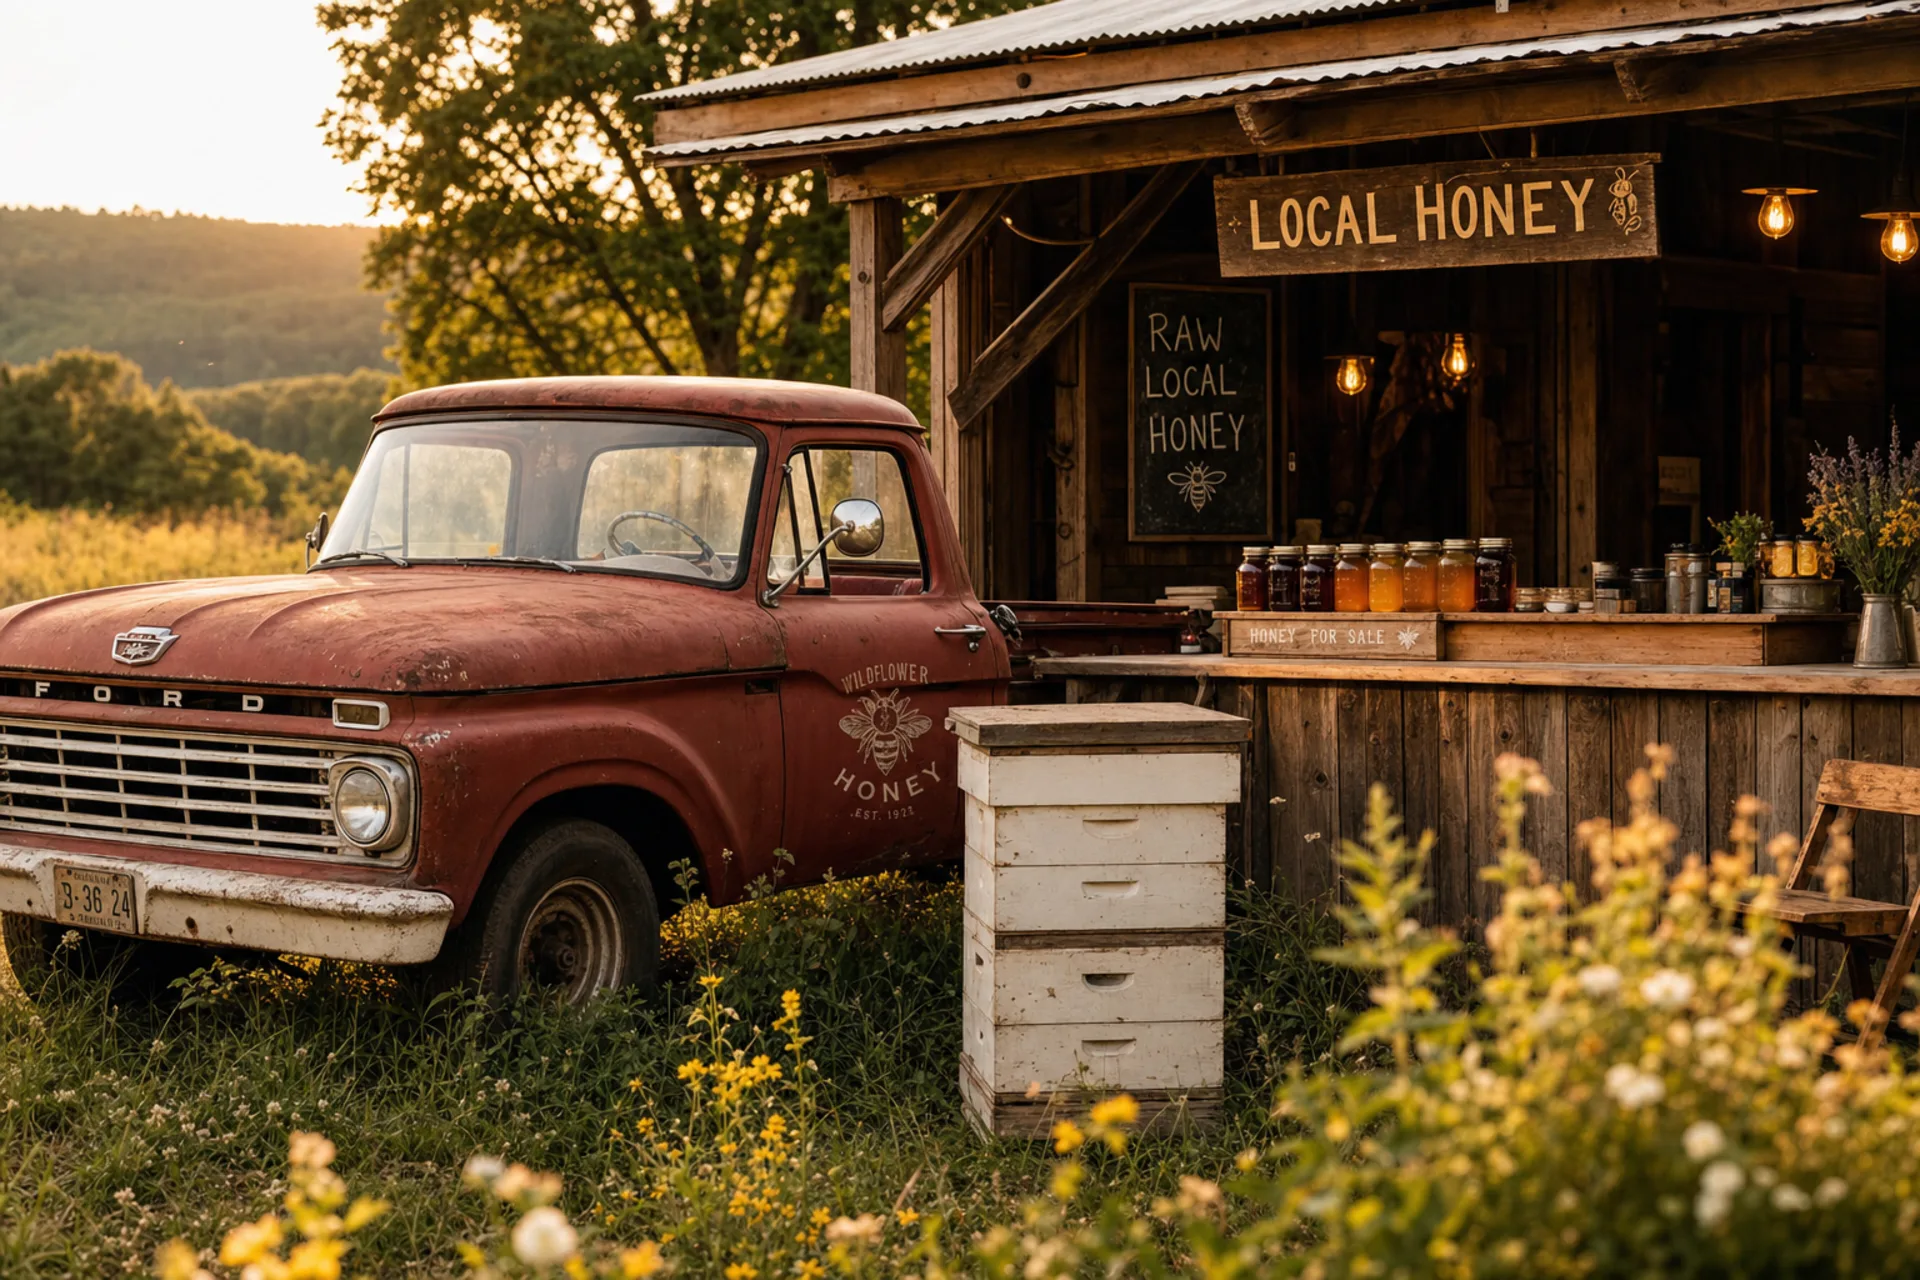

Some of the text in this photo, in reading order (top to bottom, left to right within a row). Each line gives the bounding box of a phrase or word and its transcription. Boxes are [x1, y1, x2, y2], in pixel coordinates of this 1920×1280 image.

[1250, 178, 1595, 250] LOCAL HONEY
[1149, 312, 1223, 352] RAW
[1145, 363, 1237, 398] LOCAL
[1149, 411, 1245, 454] HONEY
[1249, 627, 1385, 645] HONEY FOR SALE
[841, 662, 929, 694] WILDFLOWER
[34, 681, 265, 712] FORD
[833, 761, 941, 802] HONEY
[111, 889, 130, 918] 24
